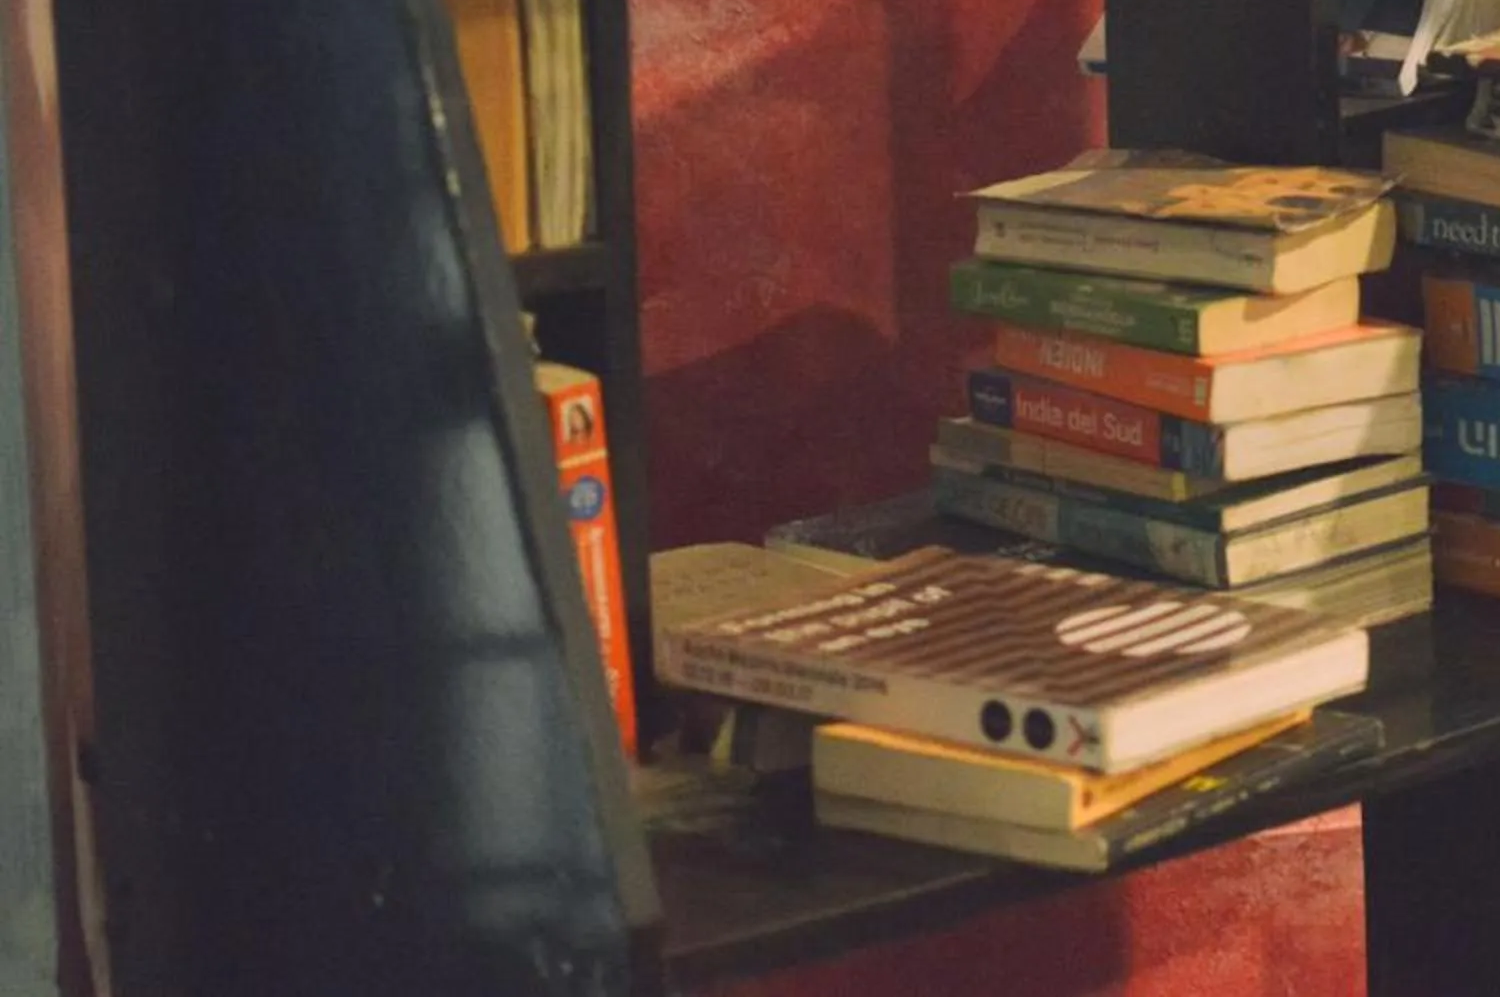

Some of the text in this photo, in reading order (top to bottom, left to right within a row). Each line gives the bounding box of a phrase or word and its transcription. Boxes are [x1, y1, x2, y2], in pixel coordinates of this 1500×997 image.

[1432, 213, 1488, 246] need
[1015, 389, 1064, 428] India
[1067, 406, 1099, 434] del
[1102, 411, 1143, 446] Sud
